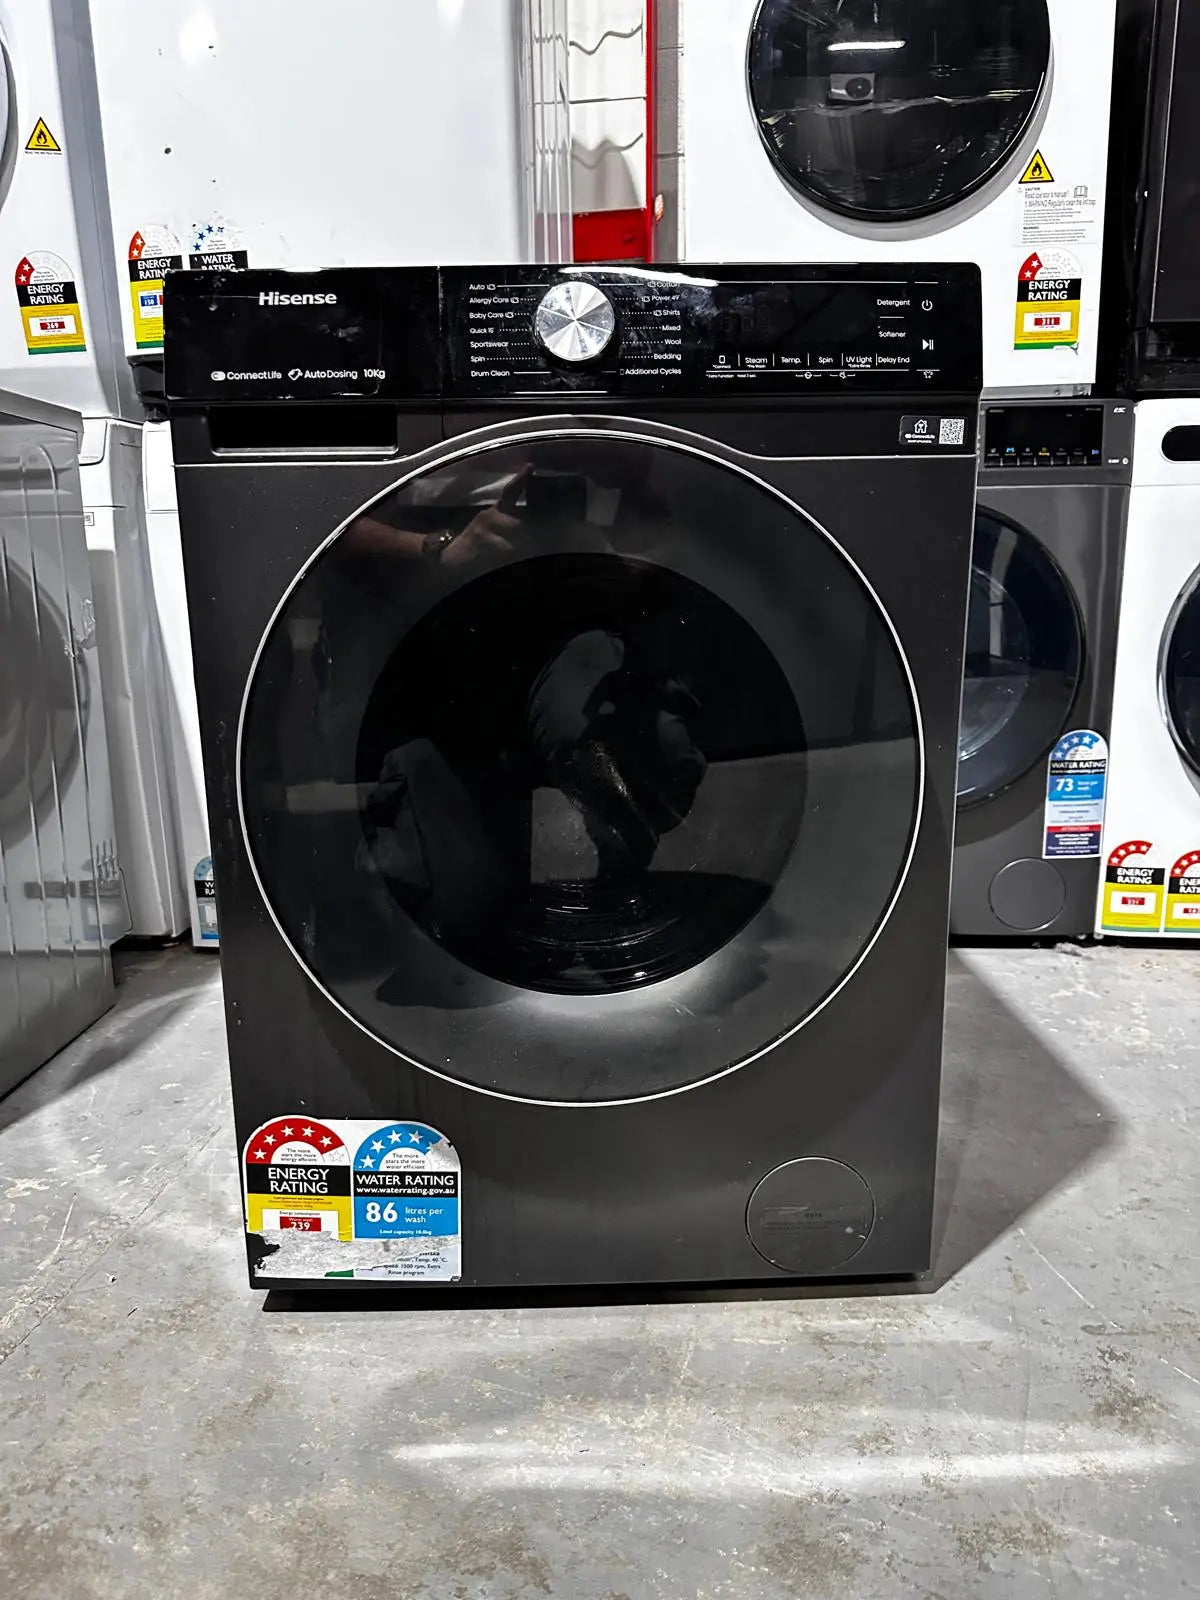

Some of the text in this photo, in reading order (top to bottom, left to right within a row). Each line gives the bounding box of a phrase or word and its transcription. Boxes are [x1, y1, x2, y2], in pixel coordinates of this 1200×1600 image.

[137, 258, 171, 270] ENERGY
[202, 254, 234, 264] WATER
[27, 284, 64, 294] ENERGY
[1029, 280, 1070, 290] ENERGY
[30, 295, 64, 305] RATING
[259, 292, 337, 306] Hisense
[1028, 291, 1067, 301] RATING
[877, 299, 910, 307] Detergent
[856, 356, 872, 364] Light
[227, 369, 386, 380] ConnectLife AutoDosing 10Kg
[1056, 778, 1074, 791] 73
[1117, 868, 1154, 876] ENERGY
[1117, 876, 1152, 884] RATING
[268, 1167, 330, 1181] ENERGY
[356, 1174, 454, 1186] WATER RATING
[270, 1181, 328, 1193] RATING
[356, 1187, 455, 1196] www.waterrating.gov.au
[366, 1201, 398, 1223] 86
[429, 1208, 443, 1216] per
[290, 1222, 310, 1230] 239
